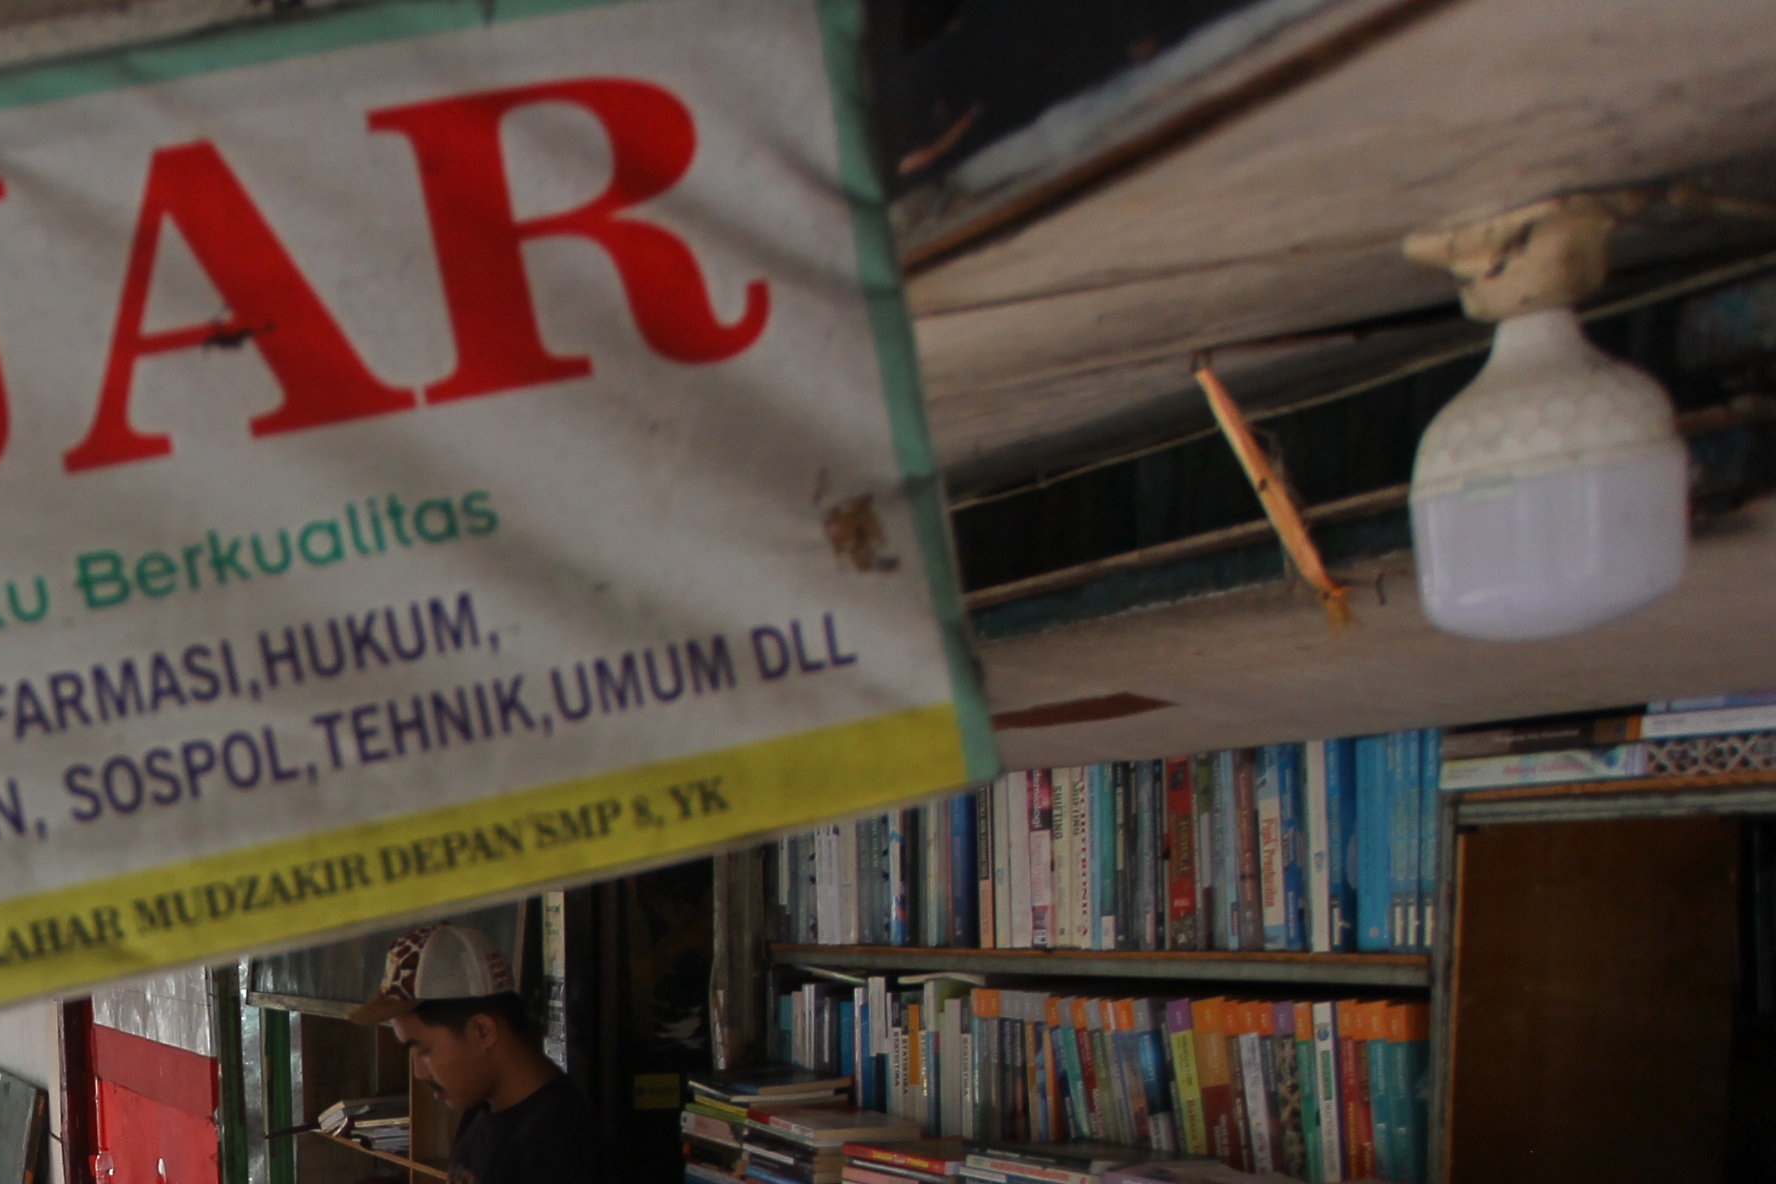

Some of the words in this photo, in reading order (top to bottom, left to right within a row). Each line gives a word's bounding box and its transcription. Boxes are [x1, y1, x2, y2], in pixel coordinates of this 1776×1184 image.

[73, 488, 500, 610] Berkualitas
[748, 611, 859, 683] DLL
[135, 852, 377, 939] MUDZAKIR
[381, 815, 526, 885] DEPAN
[530, 799, 622, 850] SMP
[669, 775, 730, 818] YK
